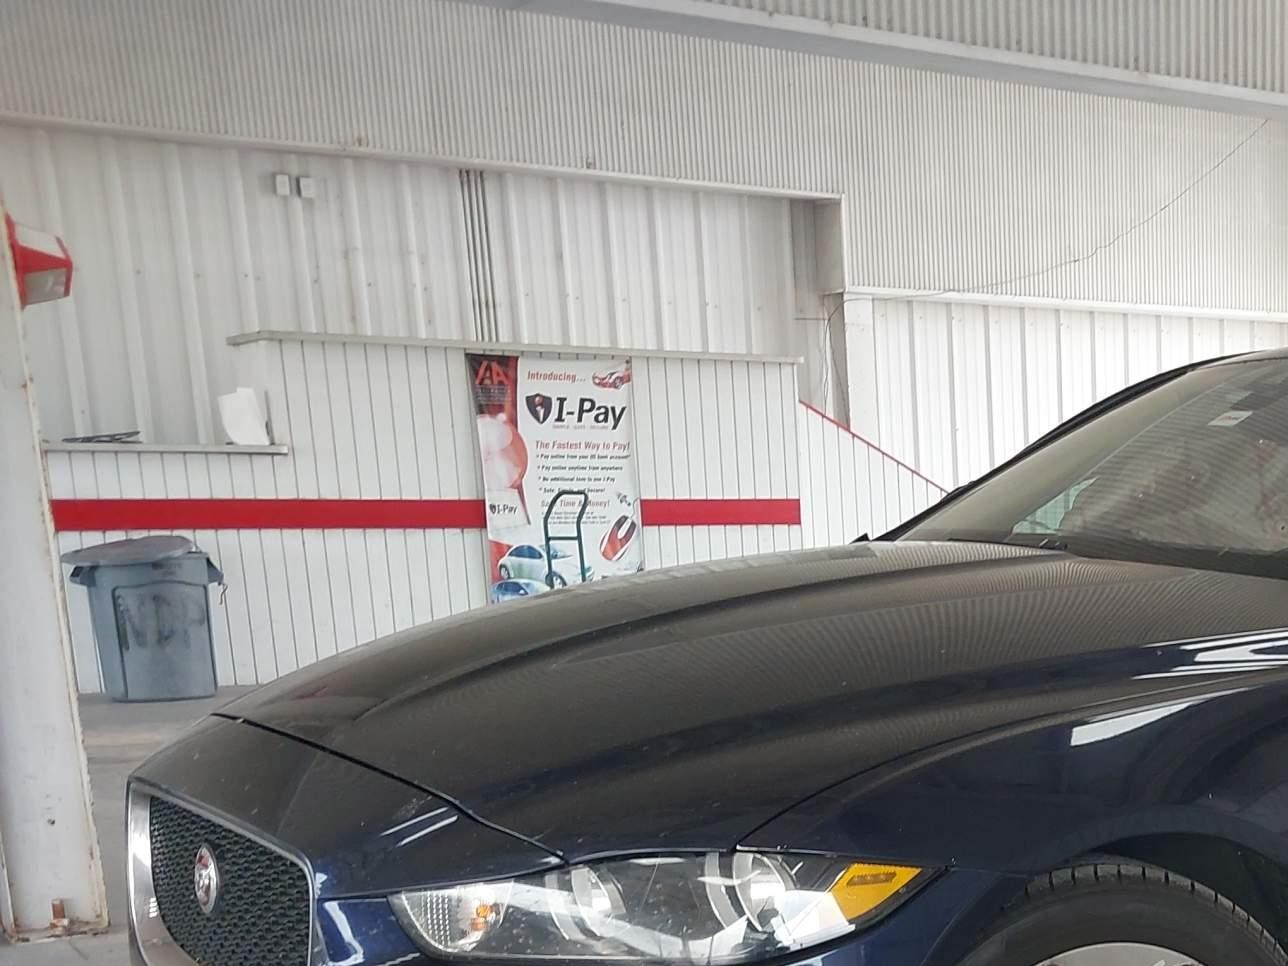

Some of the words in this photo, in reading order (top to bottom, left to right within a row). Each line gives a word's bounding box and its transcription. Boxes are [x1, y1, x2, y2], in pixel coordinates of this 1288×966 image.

[554, 397, 627, 431] I-Pay
[536, 441, 550, 450] The
[552, 441, 582, 450] Fastest
[584, 441, 601, 452] Way
[603, 442, 611, 450] to
[612, 442, 630, 453] Pay!
